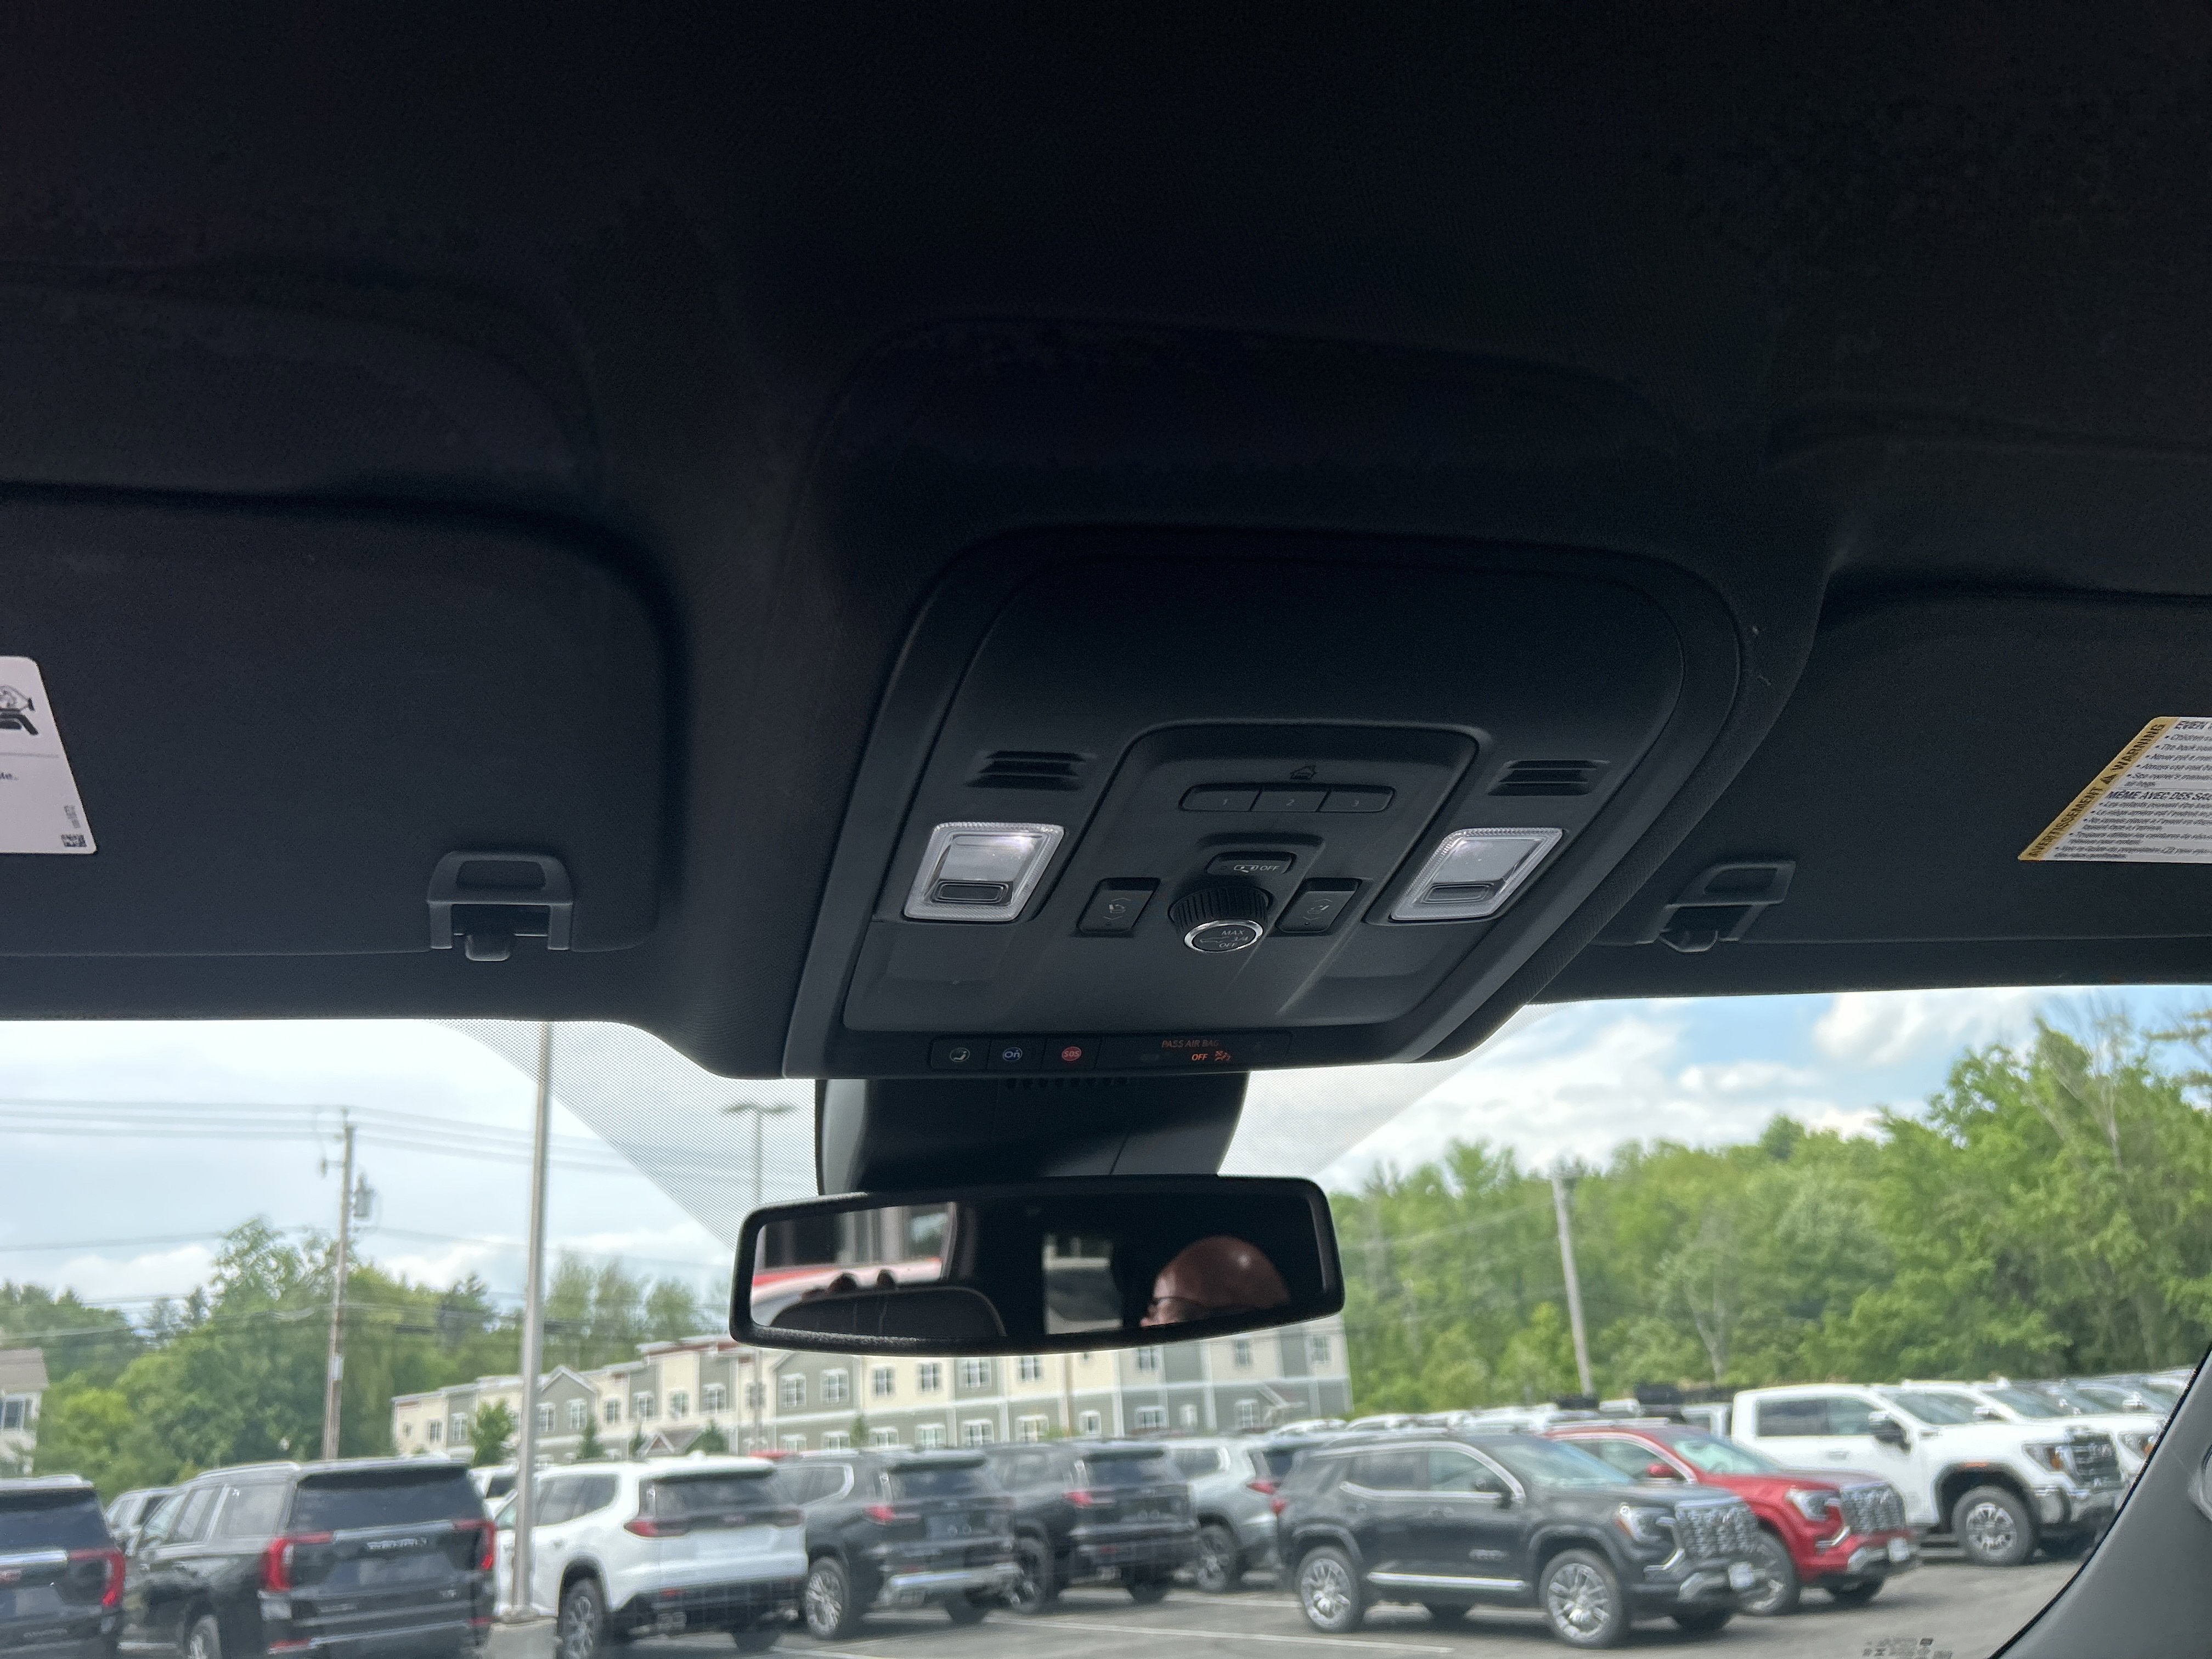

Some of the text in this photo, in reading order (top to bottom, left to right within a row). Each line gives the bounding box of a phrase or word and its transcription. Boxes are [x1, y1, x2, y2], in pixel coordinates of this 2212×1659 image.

[2111, 724, 2166, 772] WARNING
[2138, 791, 2170, 799] AVEC
[1285, 798, 1295, 806] 2
[2028, 786, 2103, 857] AVERTISSEMENT
[1161, 1040, 1183, 1048] PASS
[1184, 1040, 1200, 1048] AIR
